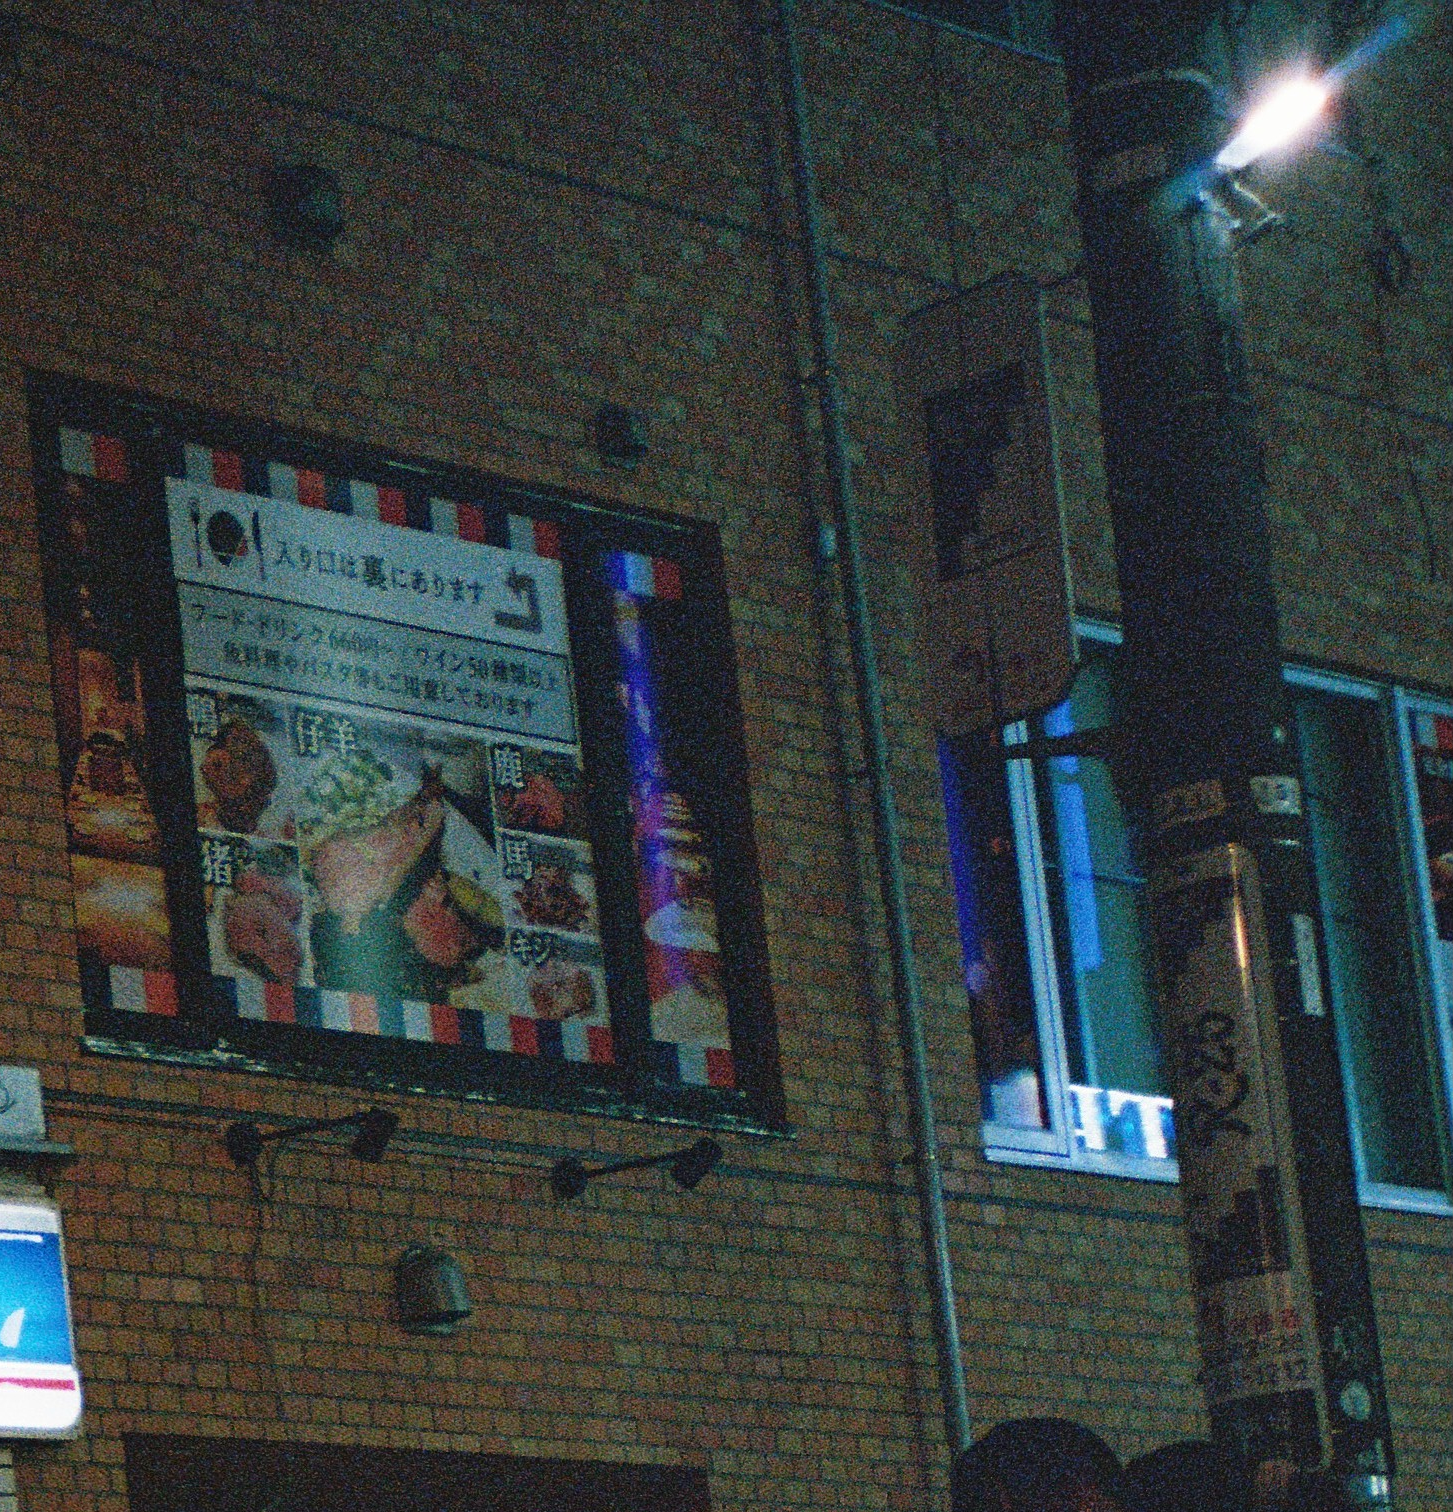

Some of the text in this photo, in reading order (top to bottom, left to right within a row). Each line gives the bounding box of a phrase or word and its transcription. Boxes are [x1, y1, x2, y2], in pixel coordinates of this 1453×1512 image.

[272, 536, 485, 606] 入り口は裏にあります
[294, 706, 358, 759] 仔羊
[200, 839, 234, 887] 猪
[502, 839, 533, 881] 馬
[509, 931, 555, 966] キジ
